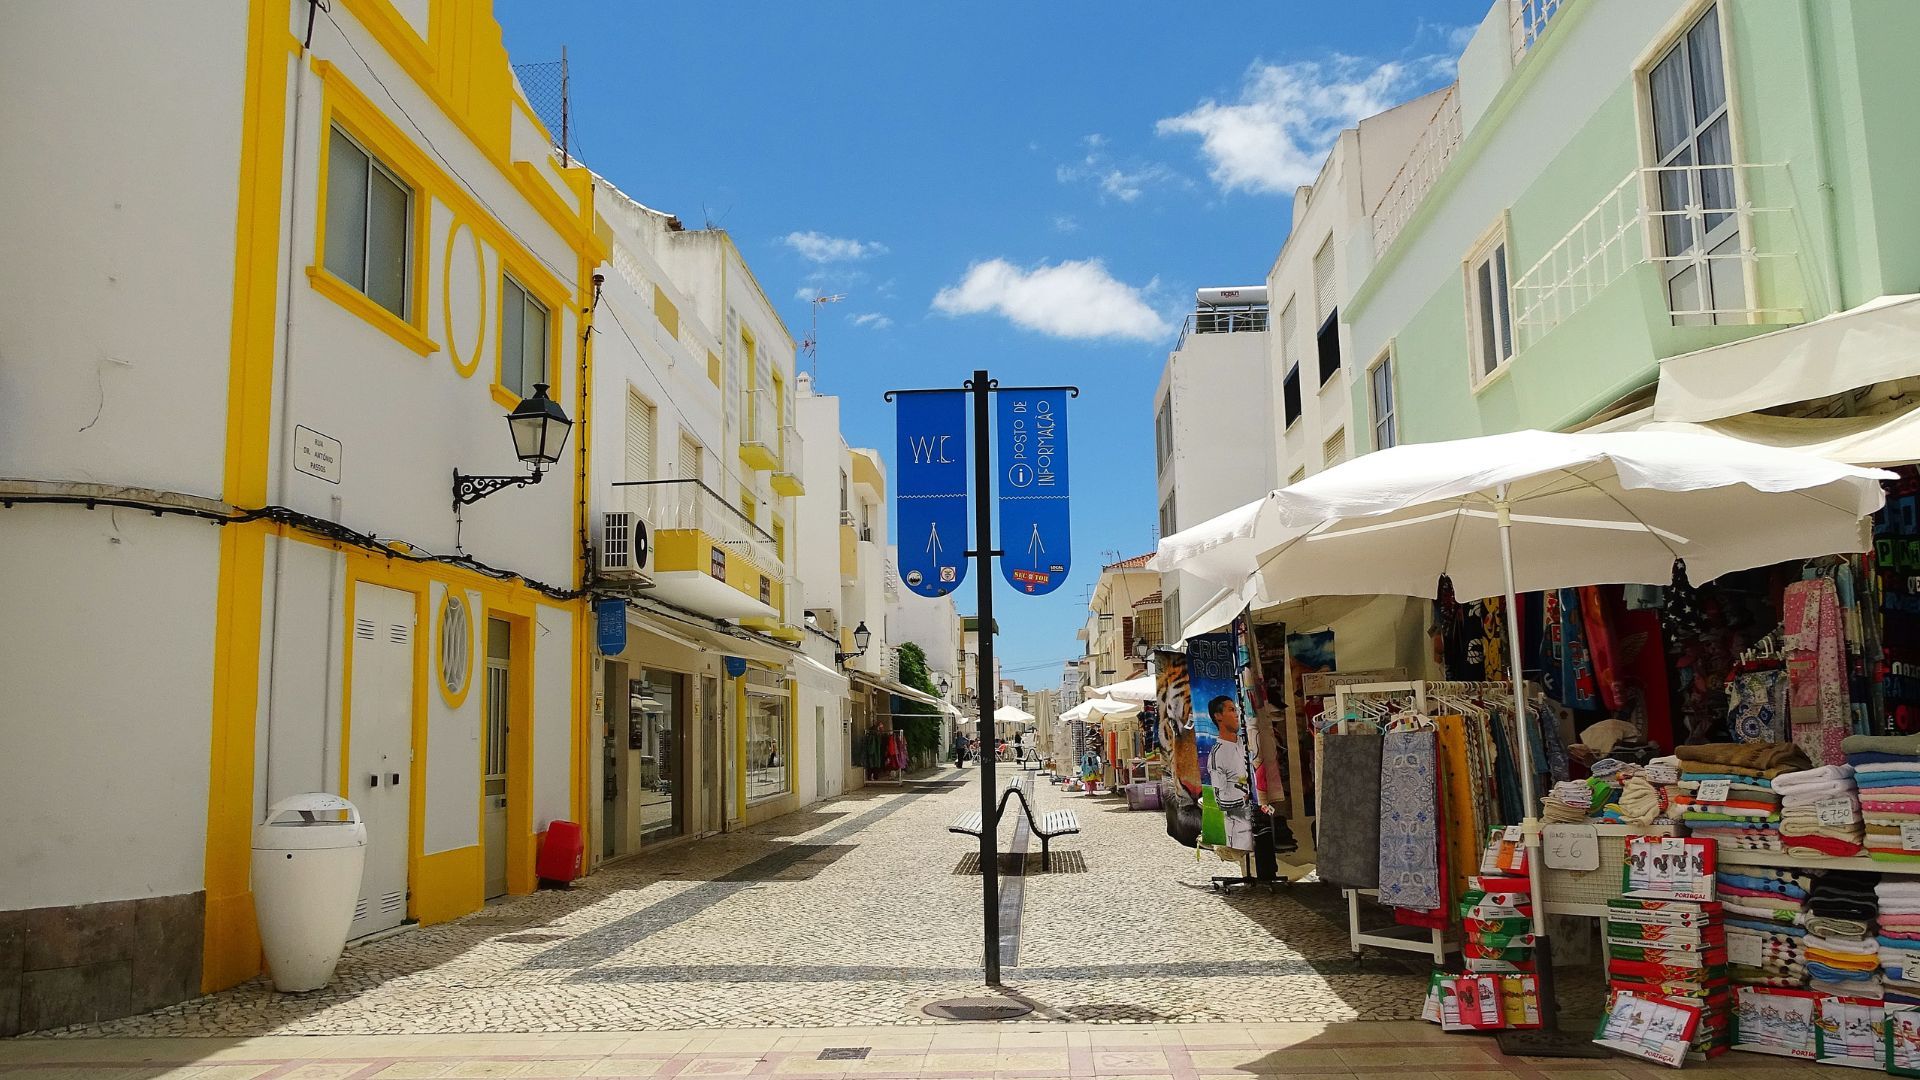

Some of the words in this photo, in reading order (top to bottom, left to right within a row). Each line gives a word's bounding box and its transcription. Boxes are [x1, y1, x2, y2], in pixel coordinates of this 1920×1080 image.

[1013, 400, 1027, 413] DE
[1013, 419, 1028, 459] POSTO
[1034, 400, 1056, 486] INFORMAÇÃO
[1188, 639, 1233, 660] CRIS
[1674, 892, 1706, 900] PORTUGAL
[1644, 1049, 1675, 1063] PORTUGAL
